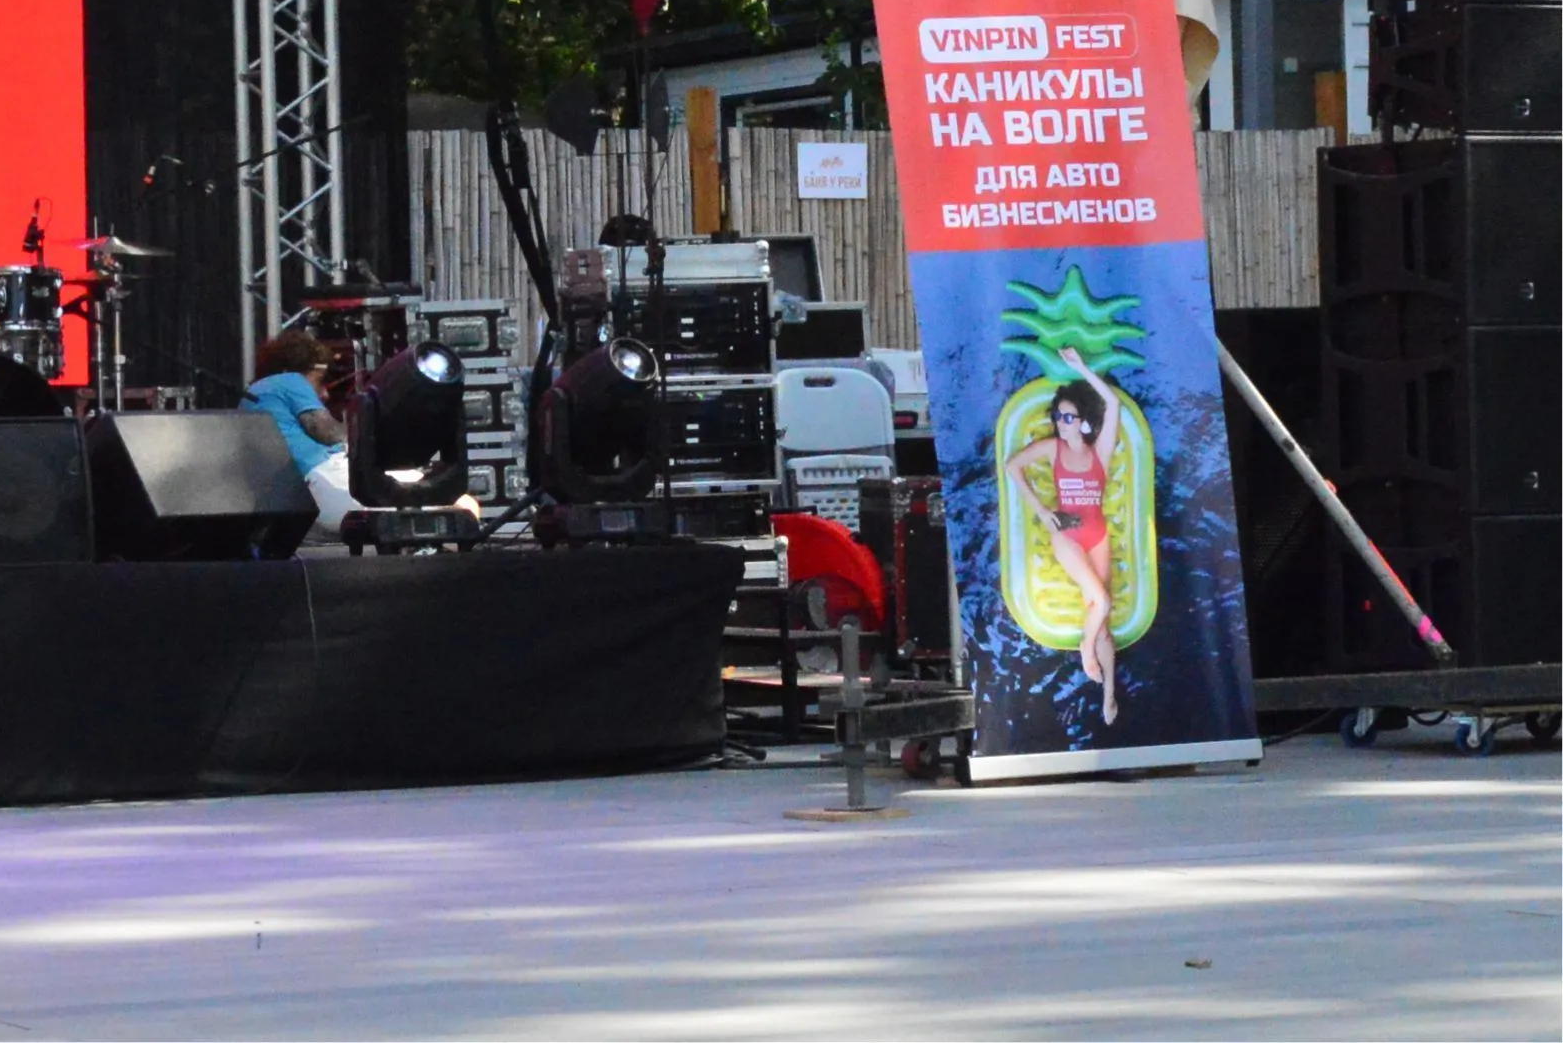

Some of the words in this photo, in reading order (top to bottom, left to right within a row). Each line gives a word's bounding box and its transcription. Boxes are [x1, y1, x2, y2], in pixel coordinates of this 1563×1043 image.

[930, 26, 1038, 52] VINPIN
[1055, 24, 1125, 49] FEST
[924, 66, 1144, 104] КАНИКУЛЫ
[929, 111, 994, 147] НА
[1003, 106, 1149, 145] ВОЛГЕ
[974, 165, 1038, 195] ДЛЯ
[1045, 162, 1121, 188] АВТО
[942, 197, 1158, 229] БИЗНЕСМЕНОВ
